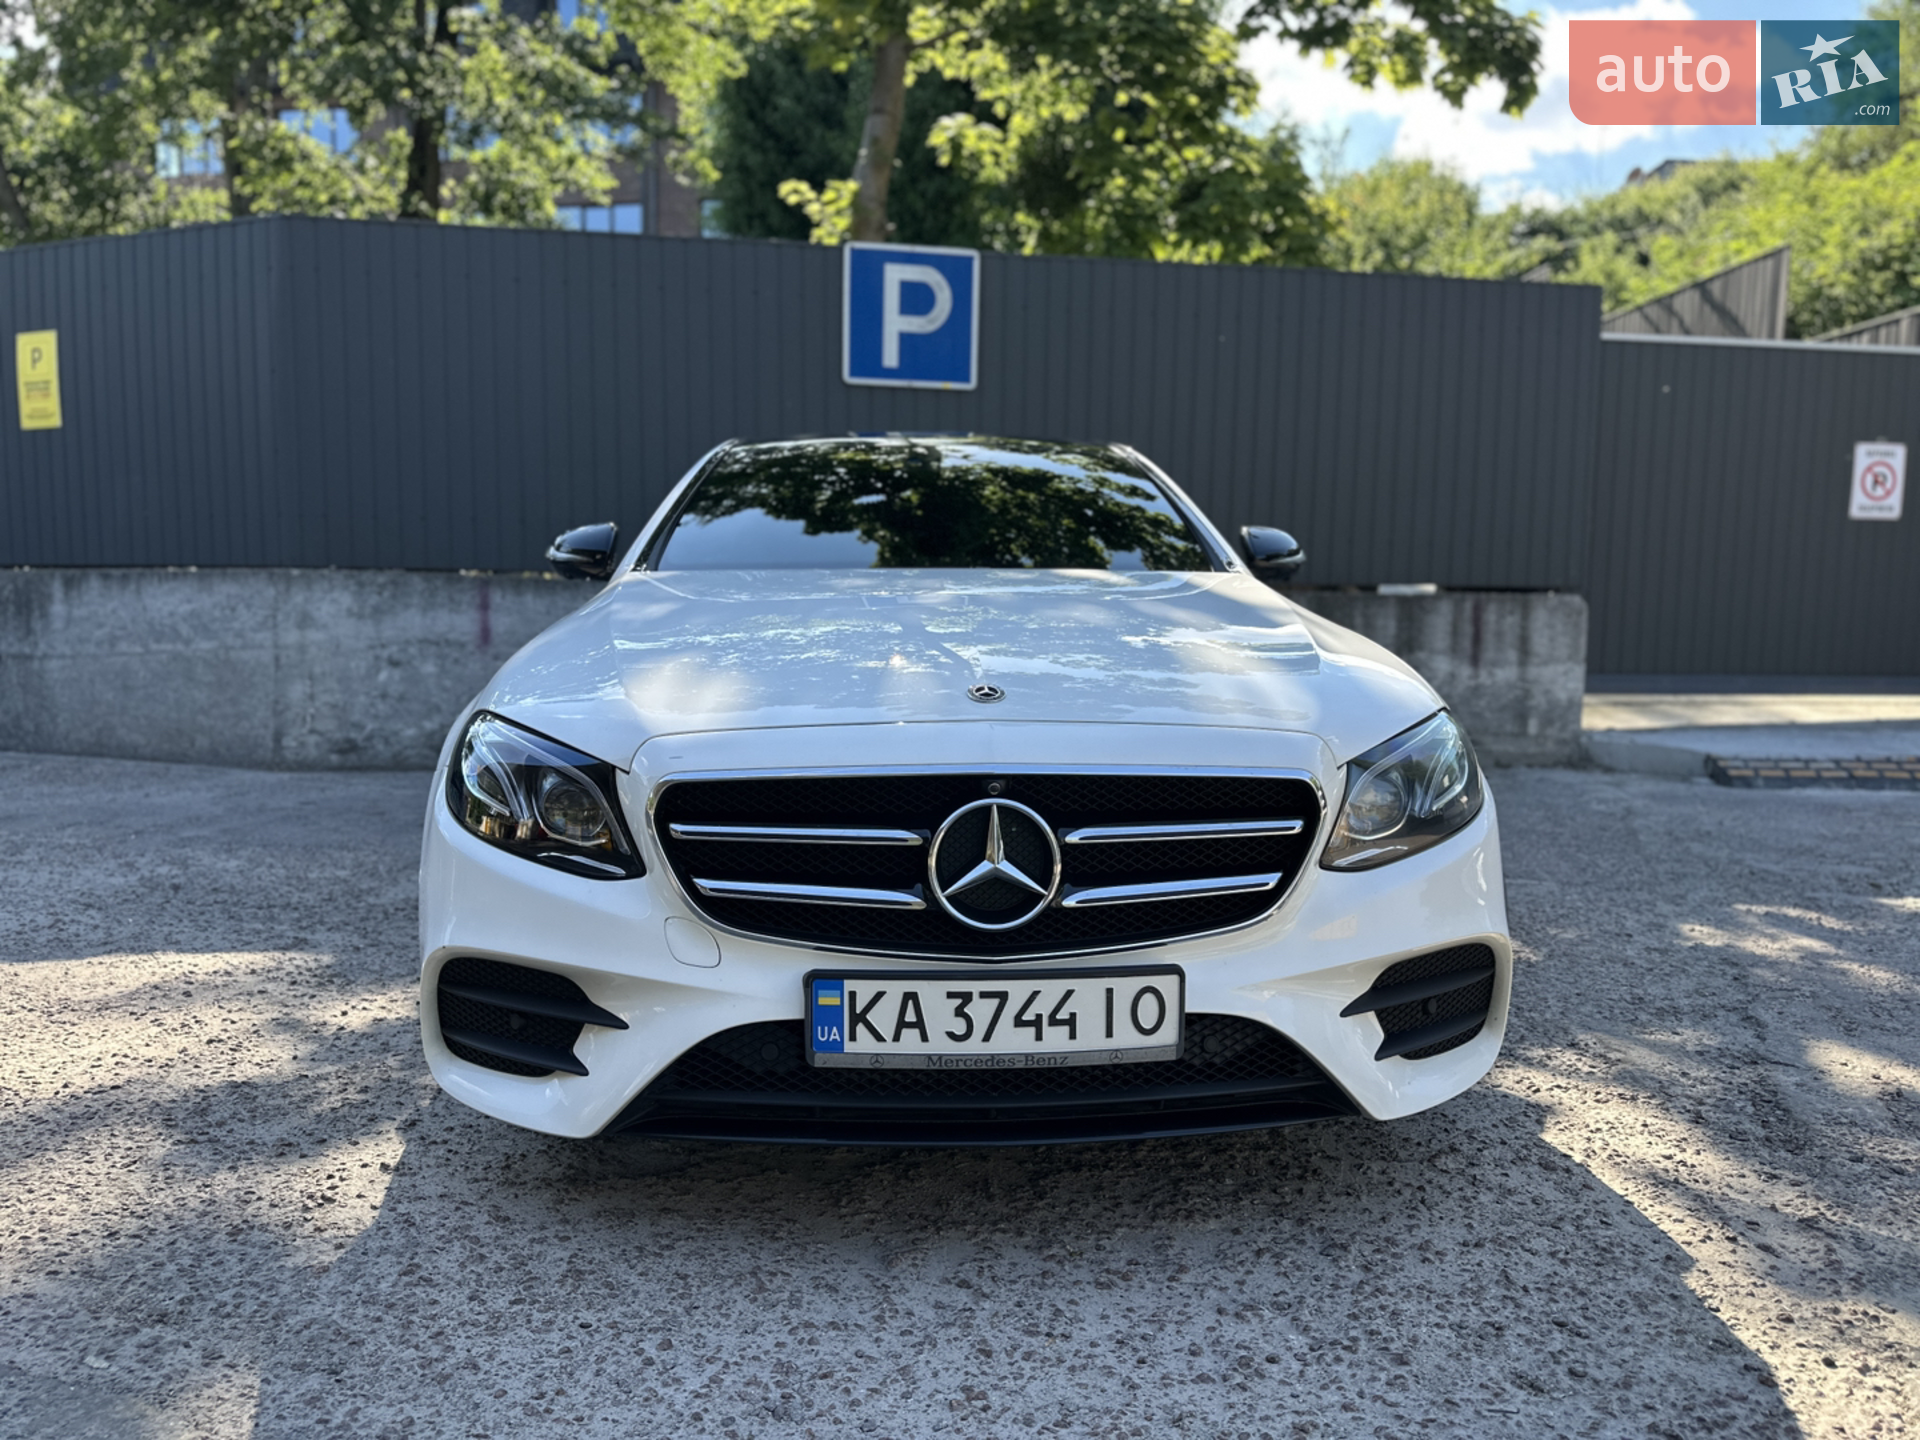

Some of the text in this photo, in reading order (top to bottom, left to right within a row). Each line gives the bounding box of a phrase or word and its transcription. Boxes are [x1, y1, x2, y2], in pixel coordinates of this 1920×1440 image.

[882, 262, 953, 369] P
[30, 346, 43, 371] P
[847, 990, 930, 1043] KA
[945, 989, 1077, 1043] 3744
[817, 1026, 841, 1042] UA
[926, 1055, 1069, 1068] Mercedes-Benz
